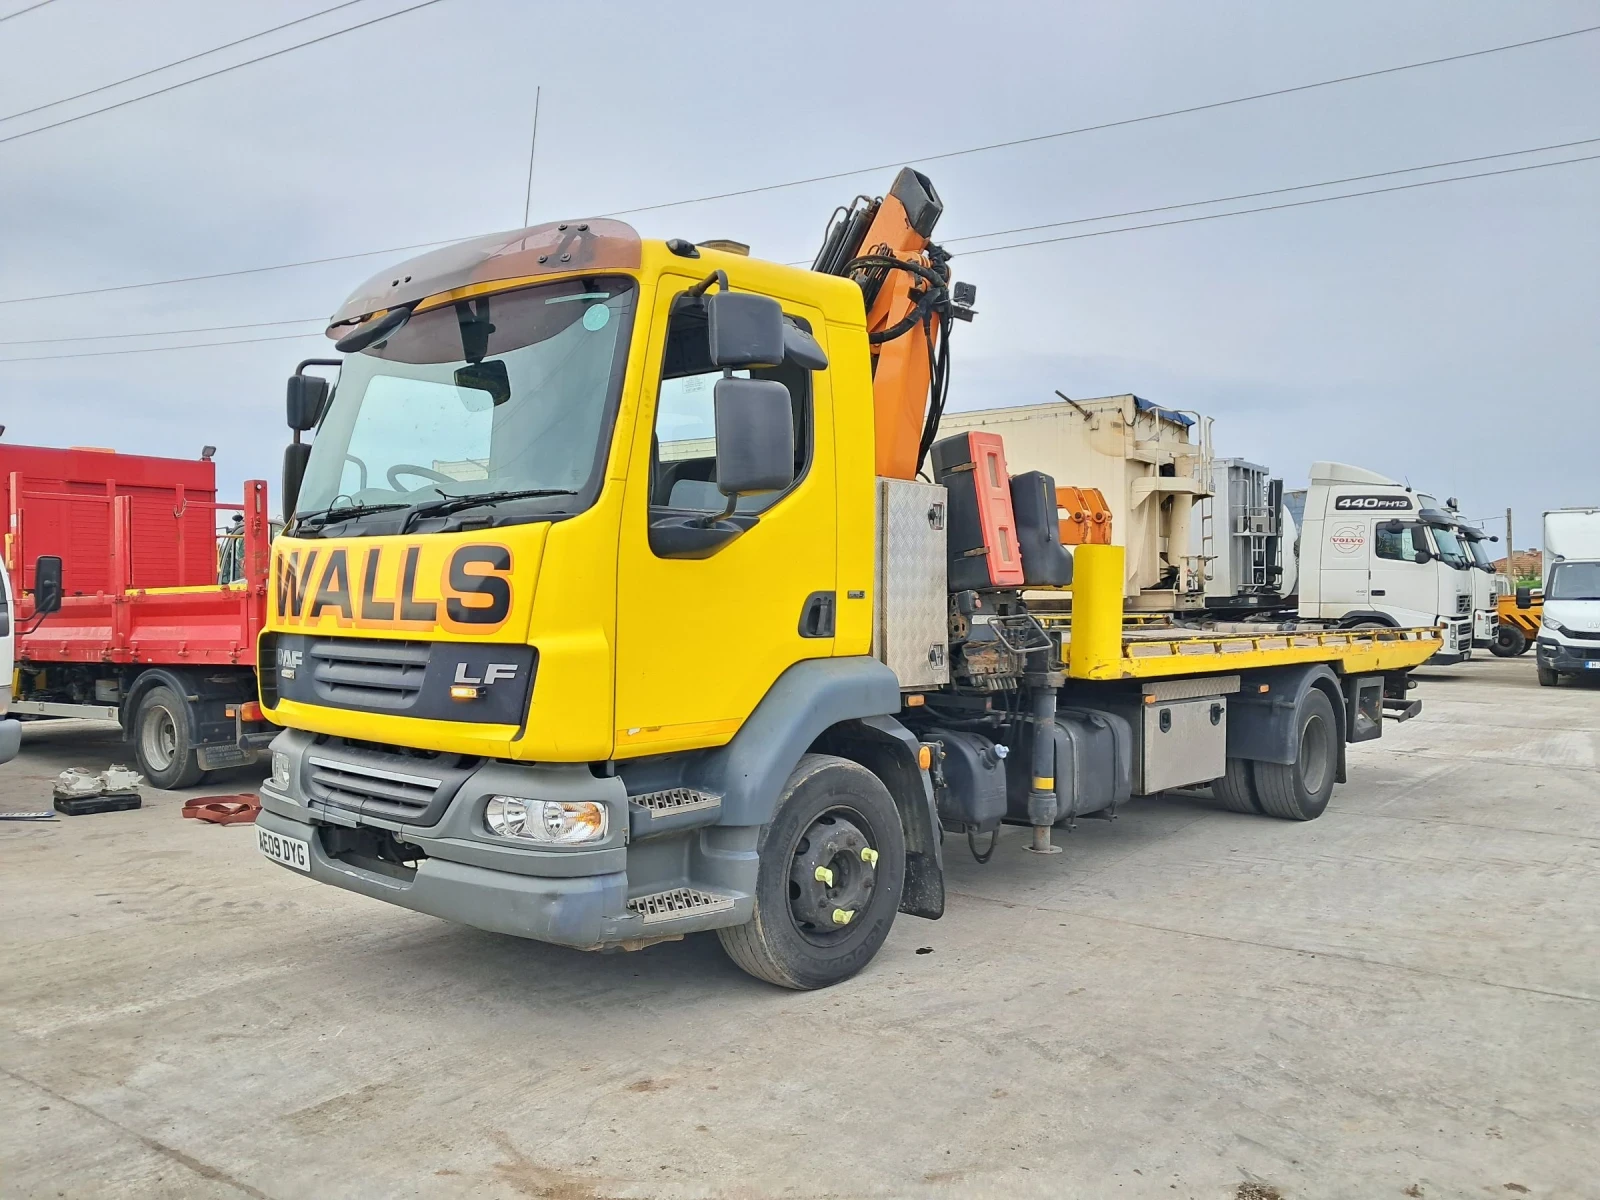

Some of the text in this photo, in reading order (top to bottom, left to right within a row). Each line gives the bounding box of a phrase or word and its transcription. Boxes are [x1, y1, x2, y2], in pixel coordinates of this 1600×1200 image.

[276, 542, 514, 634] WALLS
[277, 648, 303, 669] DAF
[454, 662, 518, 685] LF
[258, 829, 305, 866] AE09 DYG
